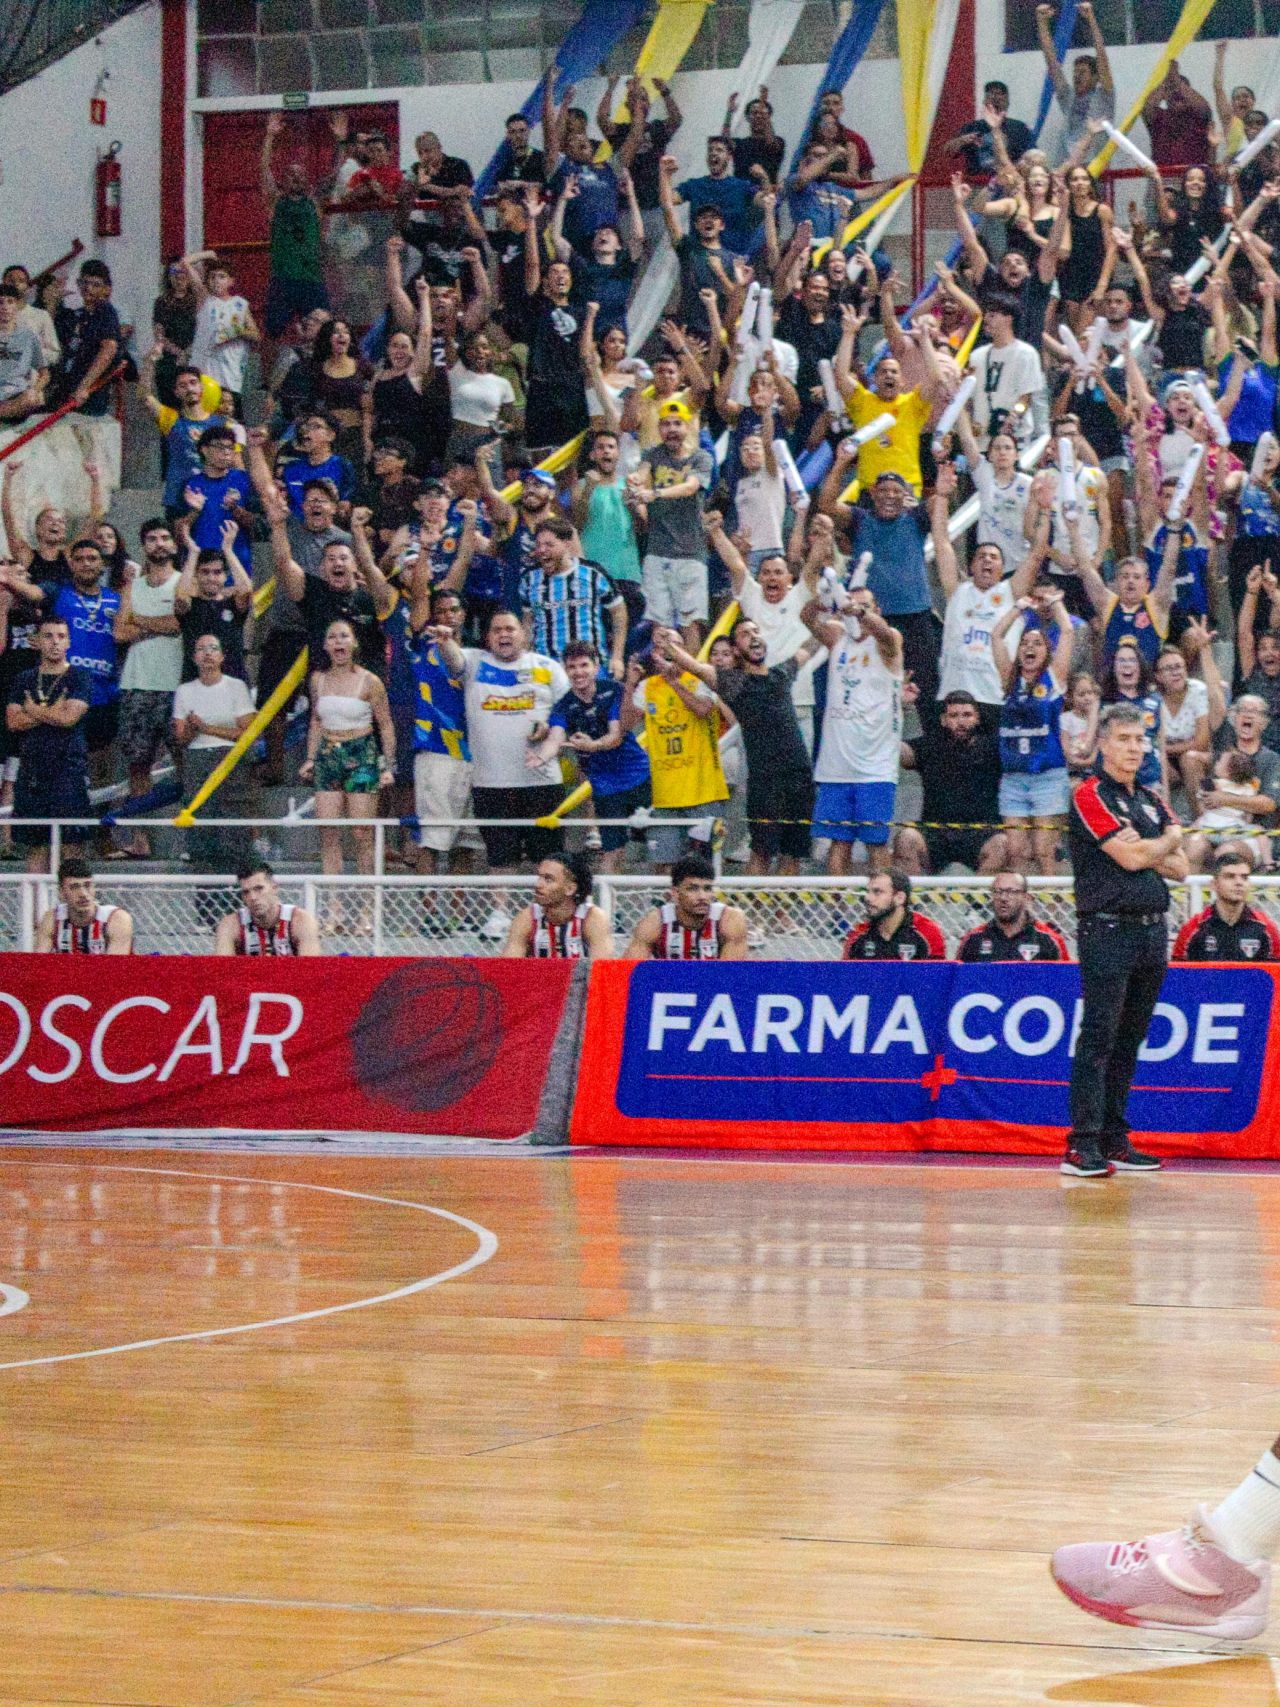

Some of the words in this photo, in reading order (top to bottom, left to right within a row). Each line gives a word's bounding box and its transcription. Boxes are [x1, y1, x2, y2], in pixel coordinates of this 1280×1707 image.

[73, 617, 113, 635] OSCA
[667, 737, 682, 755] 10
[648, 993, 928, 1054] FARMA
[947, 993, 1245, 1063] CODE
